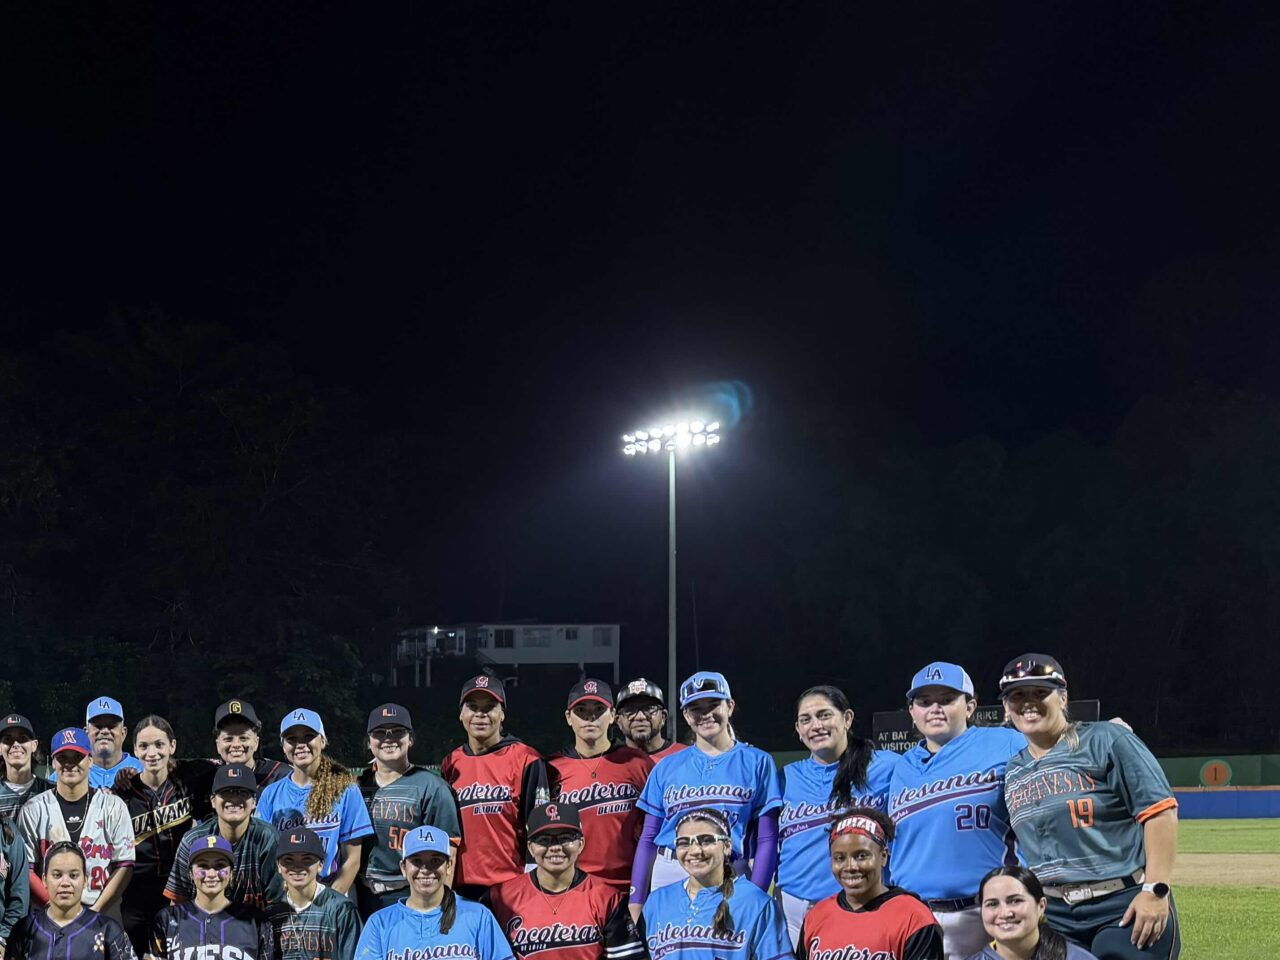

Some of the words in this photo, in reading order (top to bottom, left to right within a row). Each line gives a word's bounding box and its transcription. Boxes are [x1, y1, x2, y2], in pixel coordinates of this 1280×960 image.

[891, 731, 908, 740] BAT
[663, 784, 753, 804] Artesanas
[610, 803, 632, 813] LOIZA
[955, 804, 991, 831] 20
[1066, 798, 1094, 829] 19
